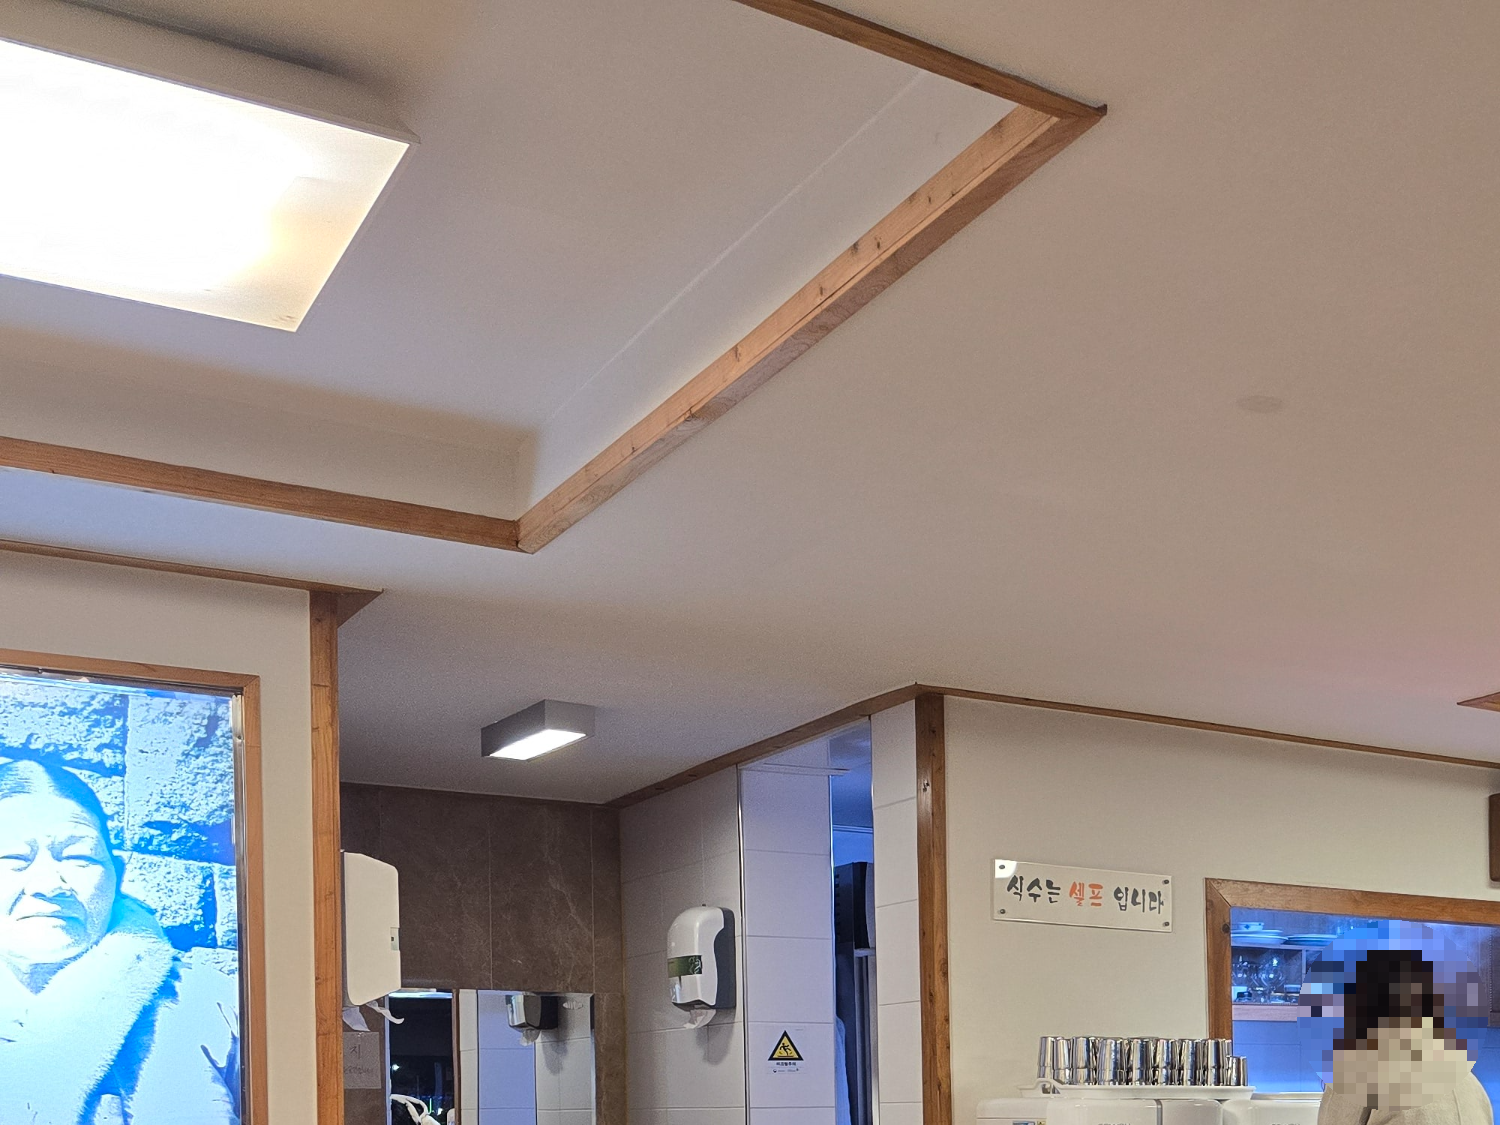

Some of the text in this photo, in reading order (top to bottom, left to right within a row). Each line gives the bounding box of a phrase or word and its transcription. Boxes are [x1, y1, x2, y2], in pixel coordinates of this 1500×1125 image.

[1007, 875, 1164, 914] 식수는 셀프 입니다
